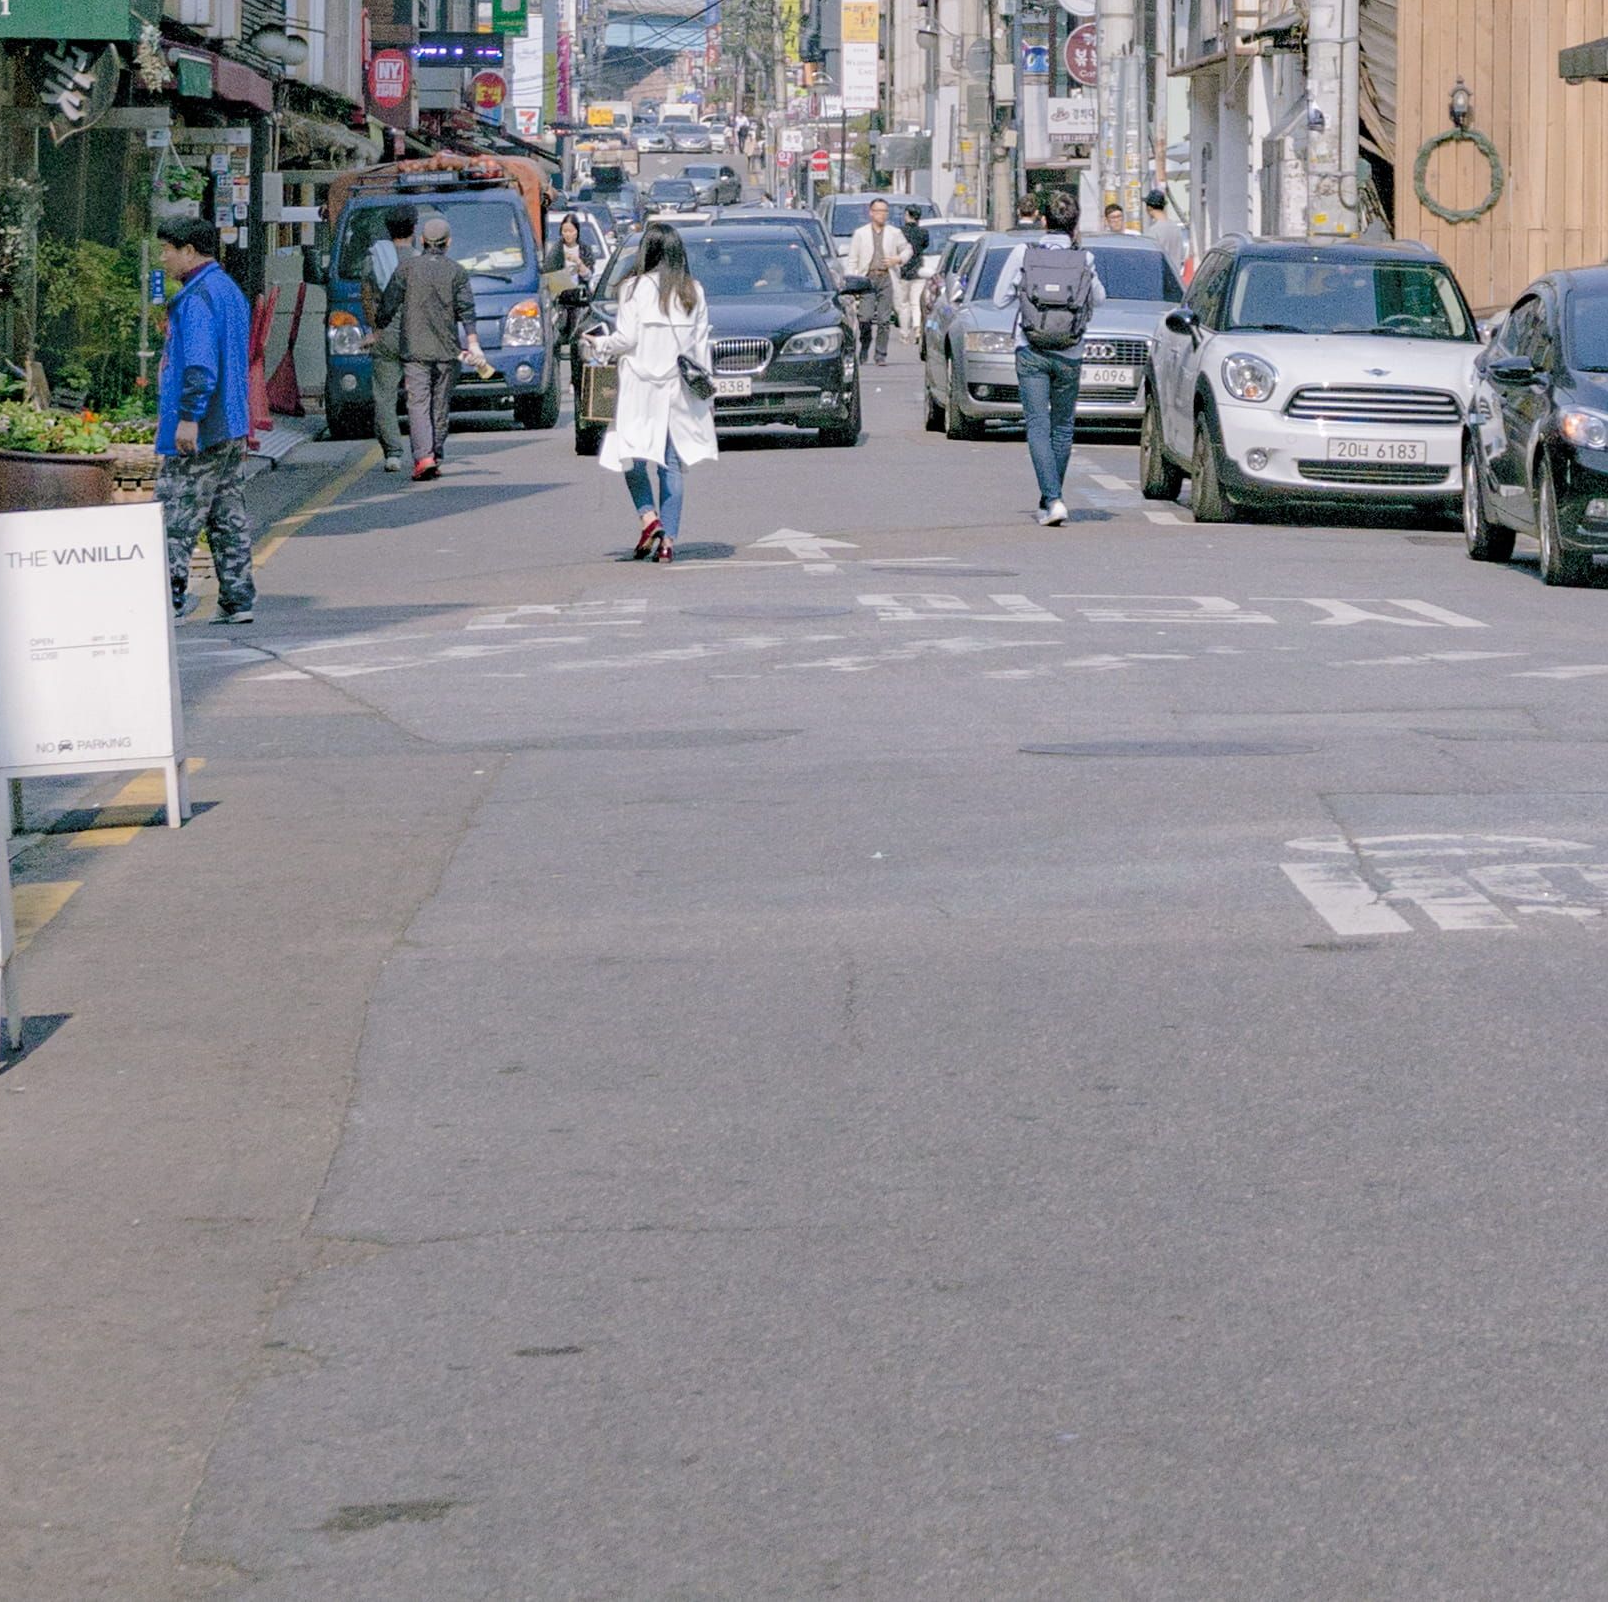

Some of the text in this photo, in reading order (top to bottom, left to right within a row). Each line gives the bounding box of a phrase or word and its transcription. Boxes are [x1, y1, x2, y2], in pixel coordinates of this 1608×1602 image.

[1092, 367, 1127, 383] 6096
[1374, 441, 1417, 460] 6183
[5, 544, 144, 569] THE VANILLA
[36, 736, 133, 754] NO PARKING
